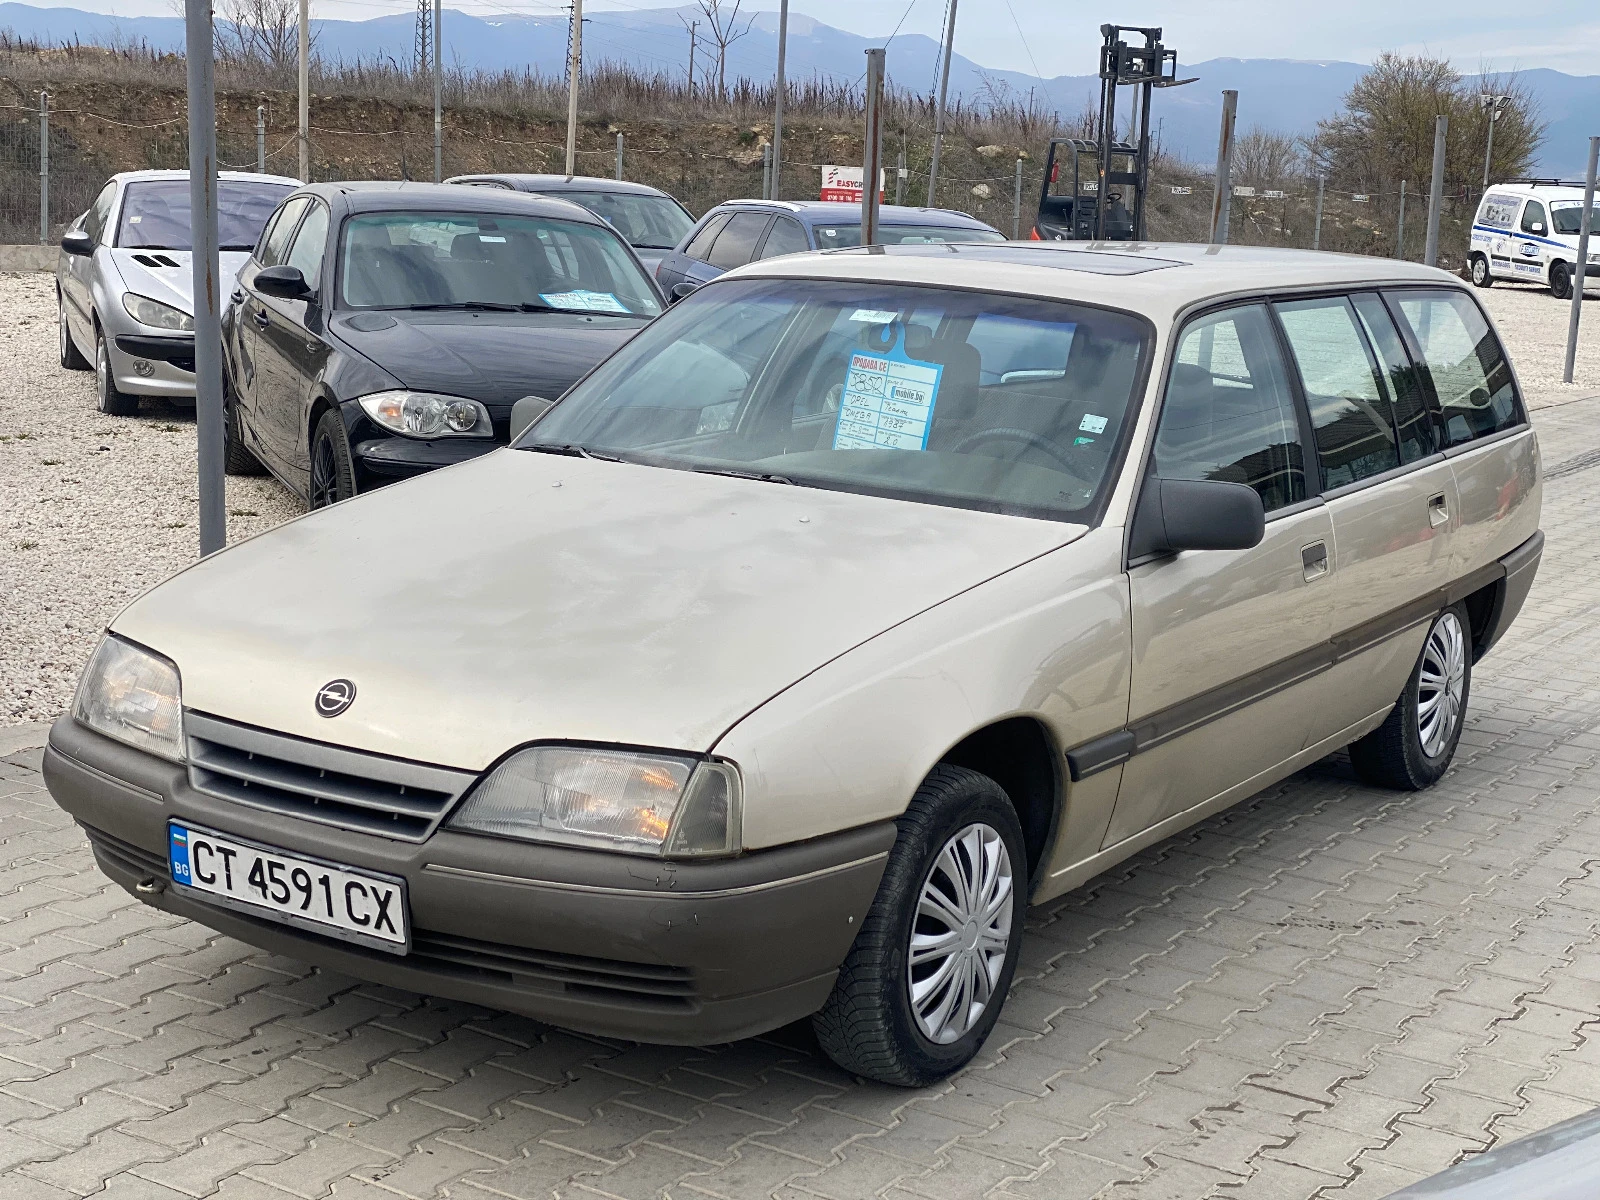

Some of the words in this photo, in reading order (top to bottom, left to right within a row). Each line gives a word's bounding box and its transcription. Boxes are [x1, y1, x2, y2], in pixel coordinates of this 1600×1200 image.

[837, 180, 863, 188] EASYCR
[853, 356, 878, 370] ПРОДАВА
[879, 361, 888, 373] СЕ
[895, 389, 925, 402] mobile.bg
[174, 861, 189, 877] BG
[192, 840, 237, 891] CT
[247, 856, 334, 918] 4591
[344, 880, 397, 934] CX
